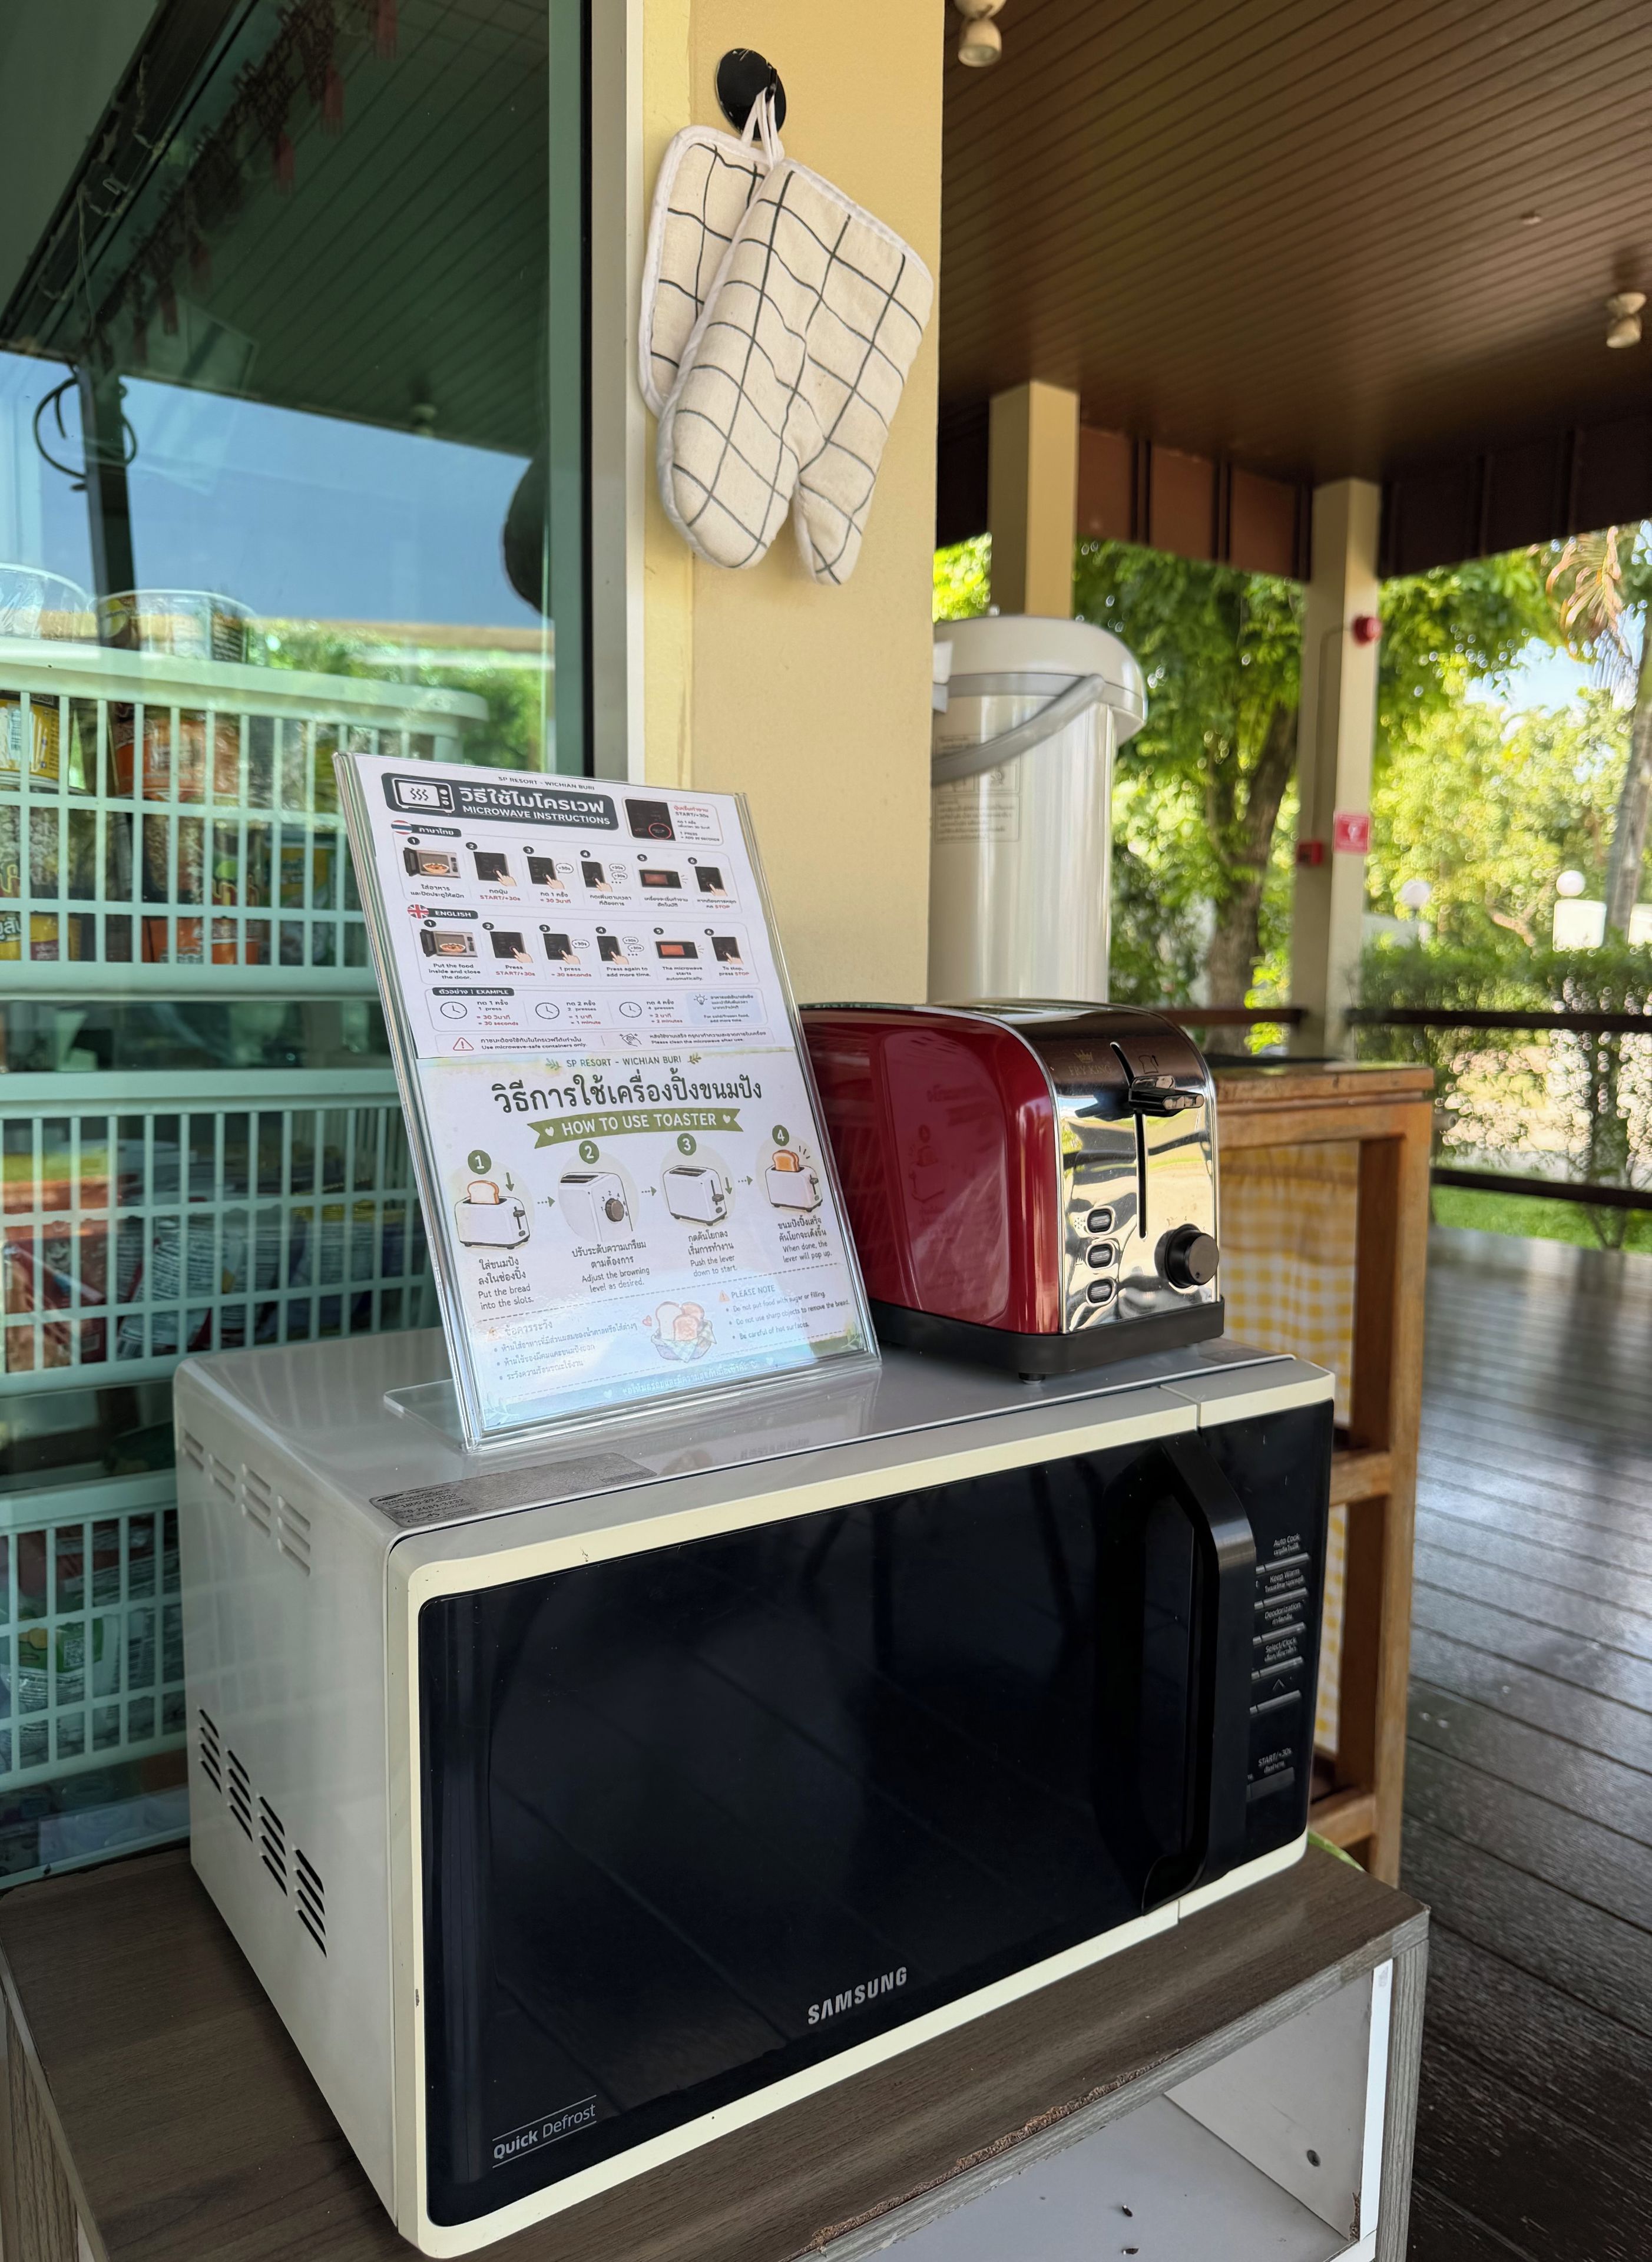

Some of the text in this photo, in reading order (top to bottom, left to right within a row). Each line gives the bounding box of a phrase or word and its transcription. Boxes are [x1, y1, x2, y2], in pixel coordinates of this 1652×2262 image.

[458, 787, 604, 813] วิธีใช้ไมโครเวฟ
[462, 805, 610, 825] MICROWAVE INSTRUCTIONS
[581, 1058, 611, 1067] RESORT
[623, 1057, 660, 1066] WICHIAN
[663, 1056, 681, 1064] BURI
[492, 1069, 763, 1113] วิธีการใช้เครื่องปิ้งขนมปัง
[562, 1113, 717, 1136] HOW TO USE TOASTER
[777, 1129, 785, 1142] 4
[683, 1137, 691, 1151] 3
[584, 1145, 594, 1159] 2
[475, 1155, 485, 1169] 1
[778, 1215, 822, 1229] ขนมปังปิ้งเสร็จ
[572, 1239, 646, 1257] ปรับระดับความเกรียม
[688, 1242, 734, 1255] เริ่มการทำงาน
[479, 1256, 519, 1270] ใส่ขนมปัง
[591, 1256, 634, 1268] ตามต้องการ
[811, 1252, 822, 1260] pop
[478, 1266, 526, 1285] ลงในช่องปิ้ง
[582, 1267, 650, 1284] Adjust the browning
[494, 1288, 507, 1297] the
[509, 1284, 531, 1294] bread
[589, 1282, 605, 1293] level
[618, 1278, 644, 1287] desired.
[731, 1285, 776, 1298] PLEASE NOTE
[498, 1298, 511, 1307] the
[514, 1296, 534, 1305] slots.
[789, 1295, 803, 1303] sugar
[766, 1312, 780, 1321] sharp
[782, 1309, 800, 1318] objects
[749, 1330, 767, 1338] careful
[786, 1321, 809, 1330] surfaces.
[1273, 1533, 1300, 1547] Auto Cook
[1270, 1569, 1300, 1583] Keep Warm
[1264, 1602, 1301, 1619] Deodorization
[1266, 1637, 1297, 1653] Select/Clock
[1258, 1747, 1292, 1767] START/+30s
[807, 1966, 908, 2025] SAMSUNG
[492, 2103, 596, 2161] Quick Defrost
